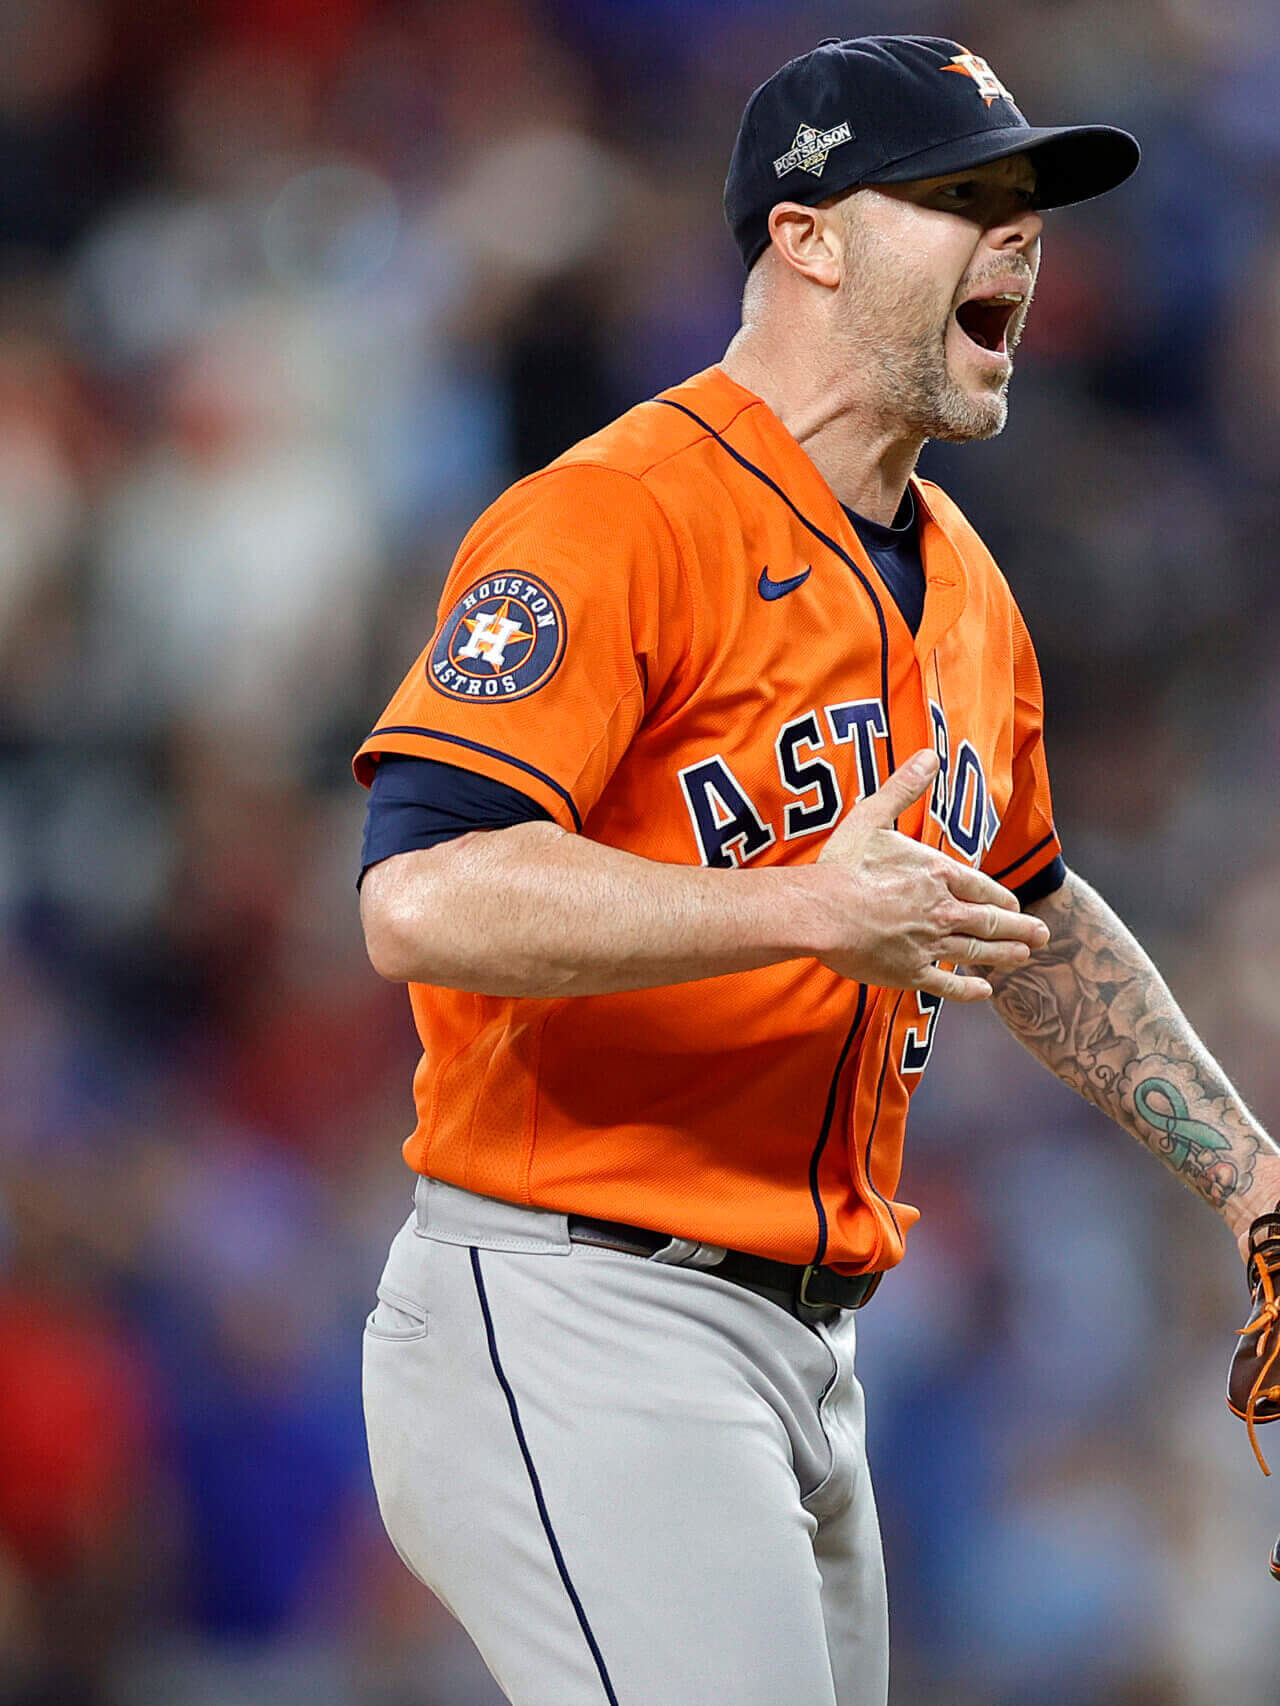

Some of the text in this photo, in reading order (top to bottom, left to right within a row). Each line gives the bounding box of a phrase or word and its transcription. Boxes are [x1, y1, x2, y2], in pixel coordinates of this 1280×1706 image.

[463, 579, 556, 628] HOUSTON
[458, 612, 522, 666] H
[433, 660, 517, 695] ASTROS
